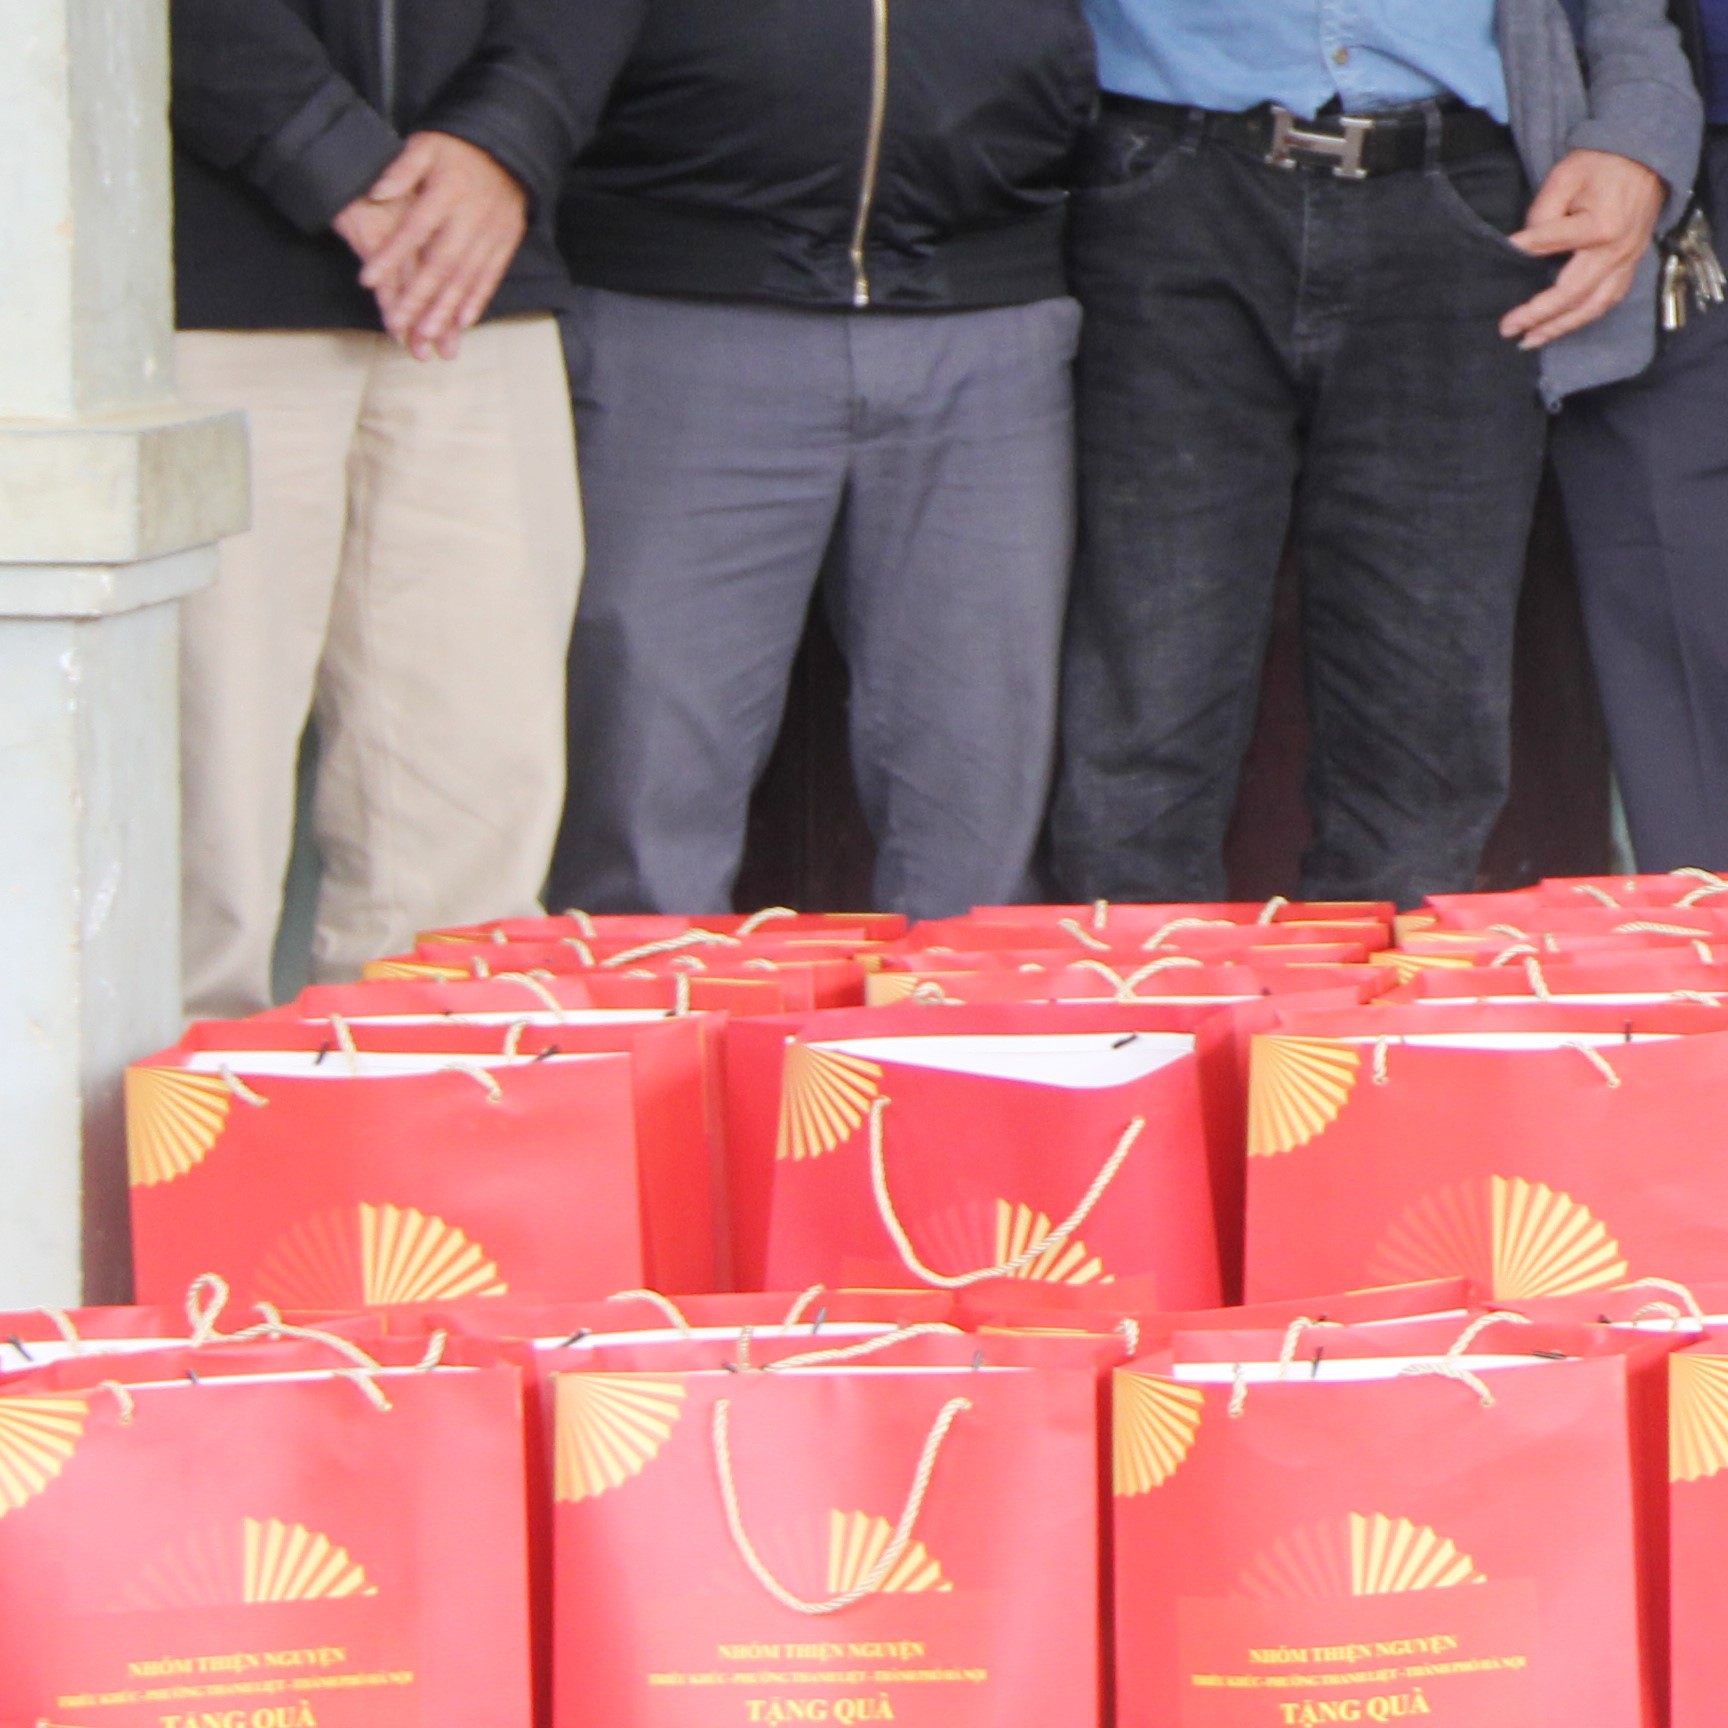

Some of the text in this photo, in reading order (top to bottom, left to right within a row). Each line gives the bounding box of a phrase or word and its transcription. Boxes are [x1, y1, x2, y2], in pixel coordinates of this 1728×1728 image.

[199, 1652, 259, 1673] THIỆN
[264, 1646, 346, 1668] NGUYỆN
[785, 1641, 844, 1662] THIỆN
[848, 1639, 925, 1661] NGUYỆN
[1311, 1643, 1372, 1663] THIỆN
[1375, 1634, 1458, 1658] NGUYỆN
[746, 1691, 894, 1726] TẶNG QUÀ
[1280, 1687, 1431, 1728] TẶNG QUÀ
